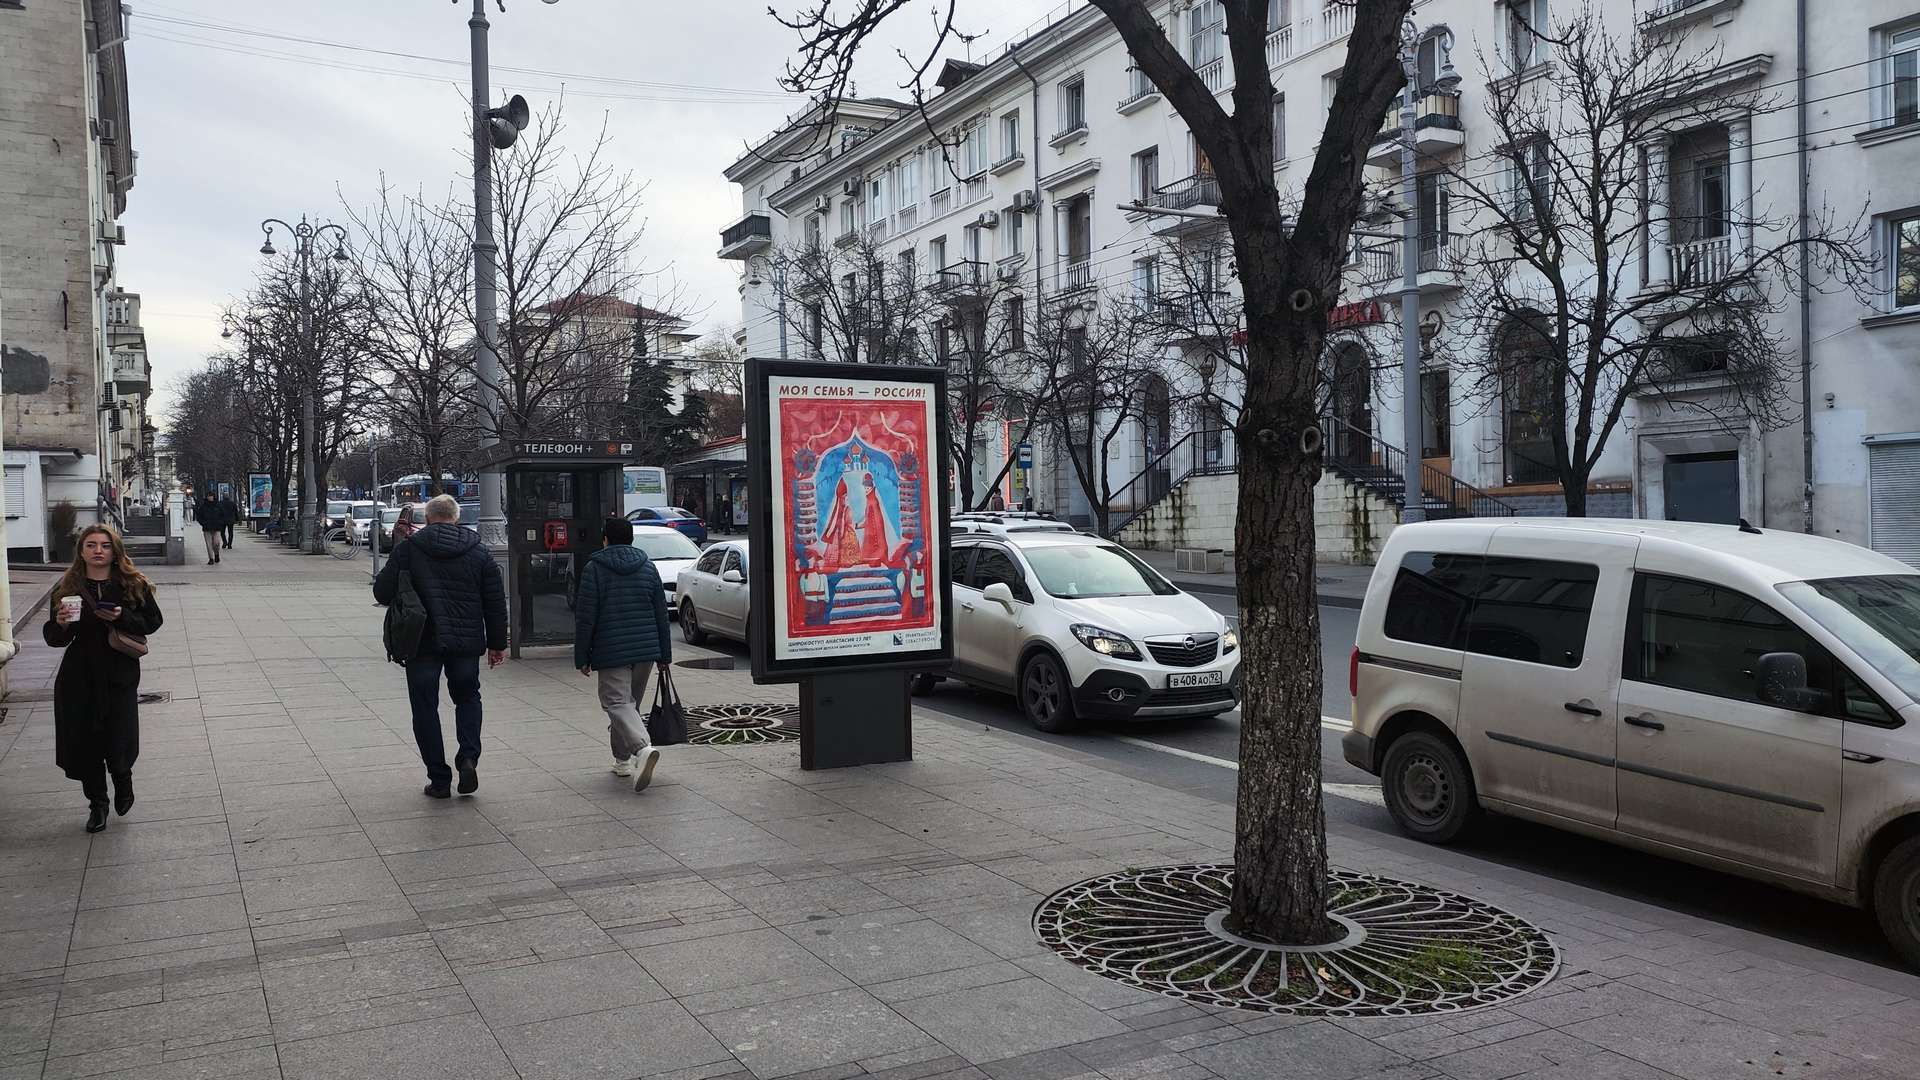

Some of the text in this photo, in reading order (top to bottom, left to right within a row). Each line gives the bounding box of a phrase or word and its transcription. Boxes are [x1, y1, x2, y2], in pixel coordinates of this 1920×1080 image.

[779, 385, 809, 396] МОЯ
[813, 386, 854, 397] СЕМЬЯ
[874, 387, 926, 398] РОССИЯ!
[523, 443, 583, 454] ТЕЛЕФОН
